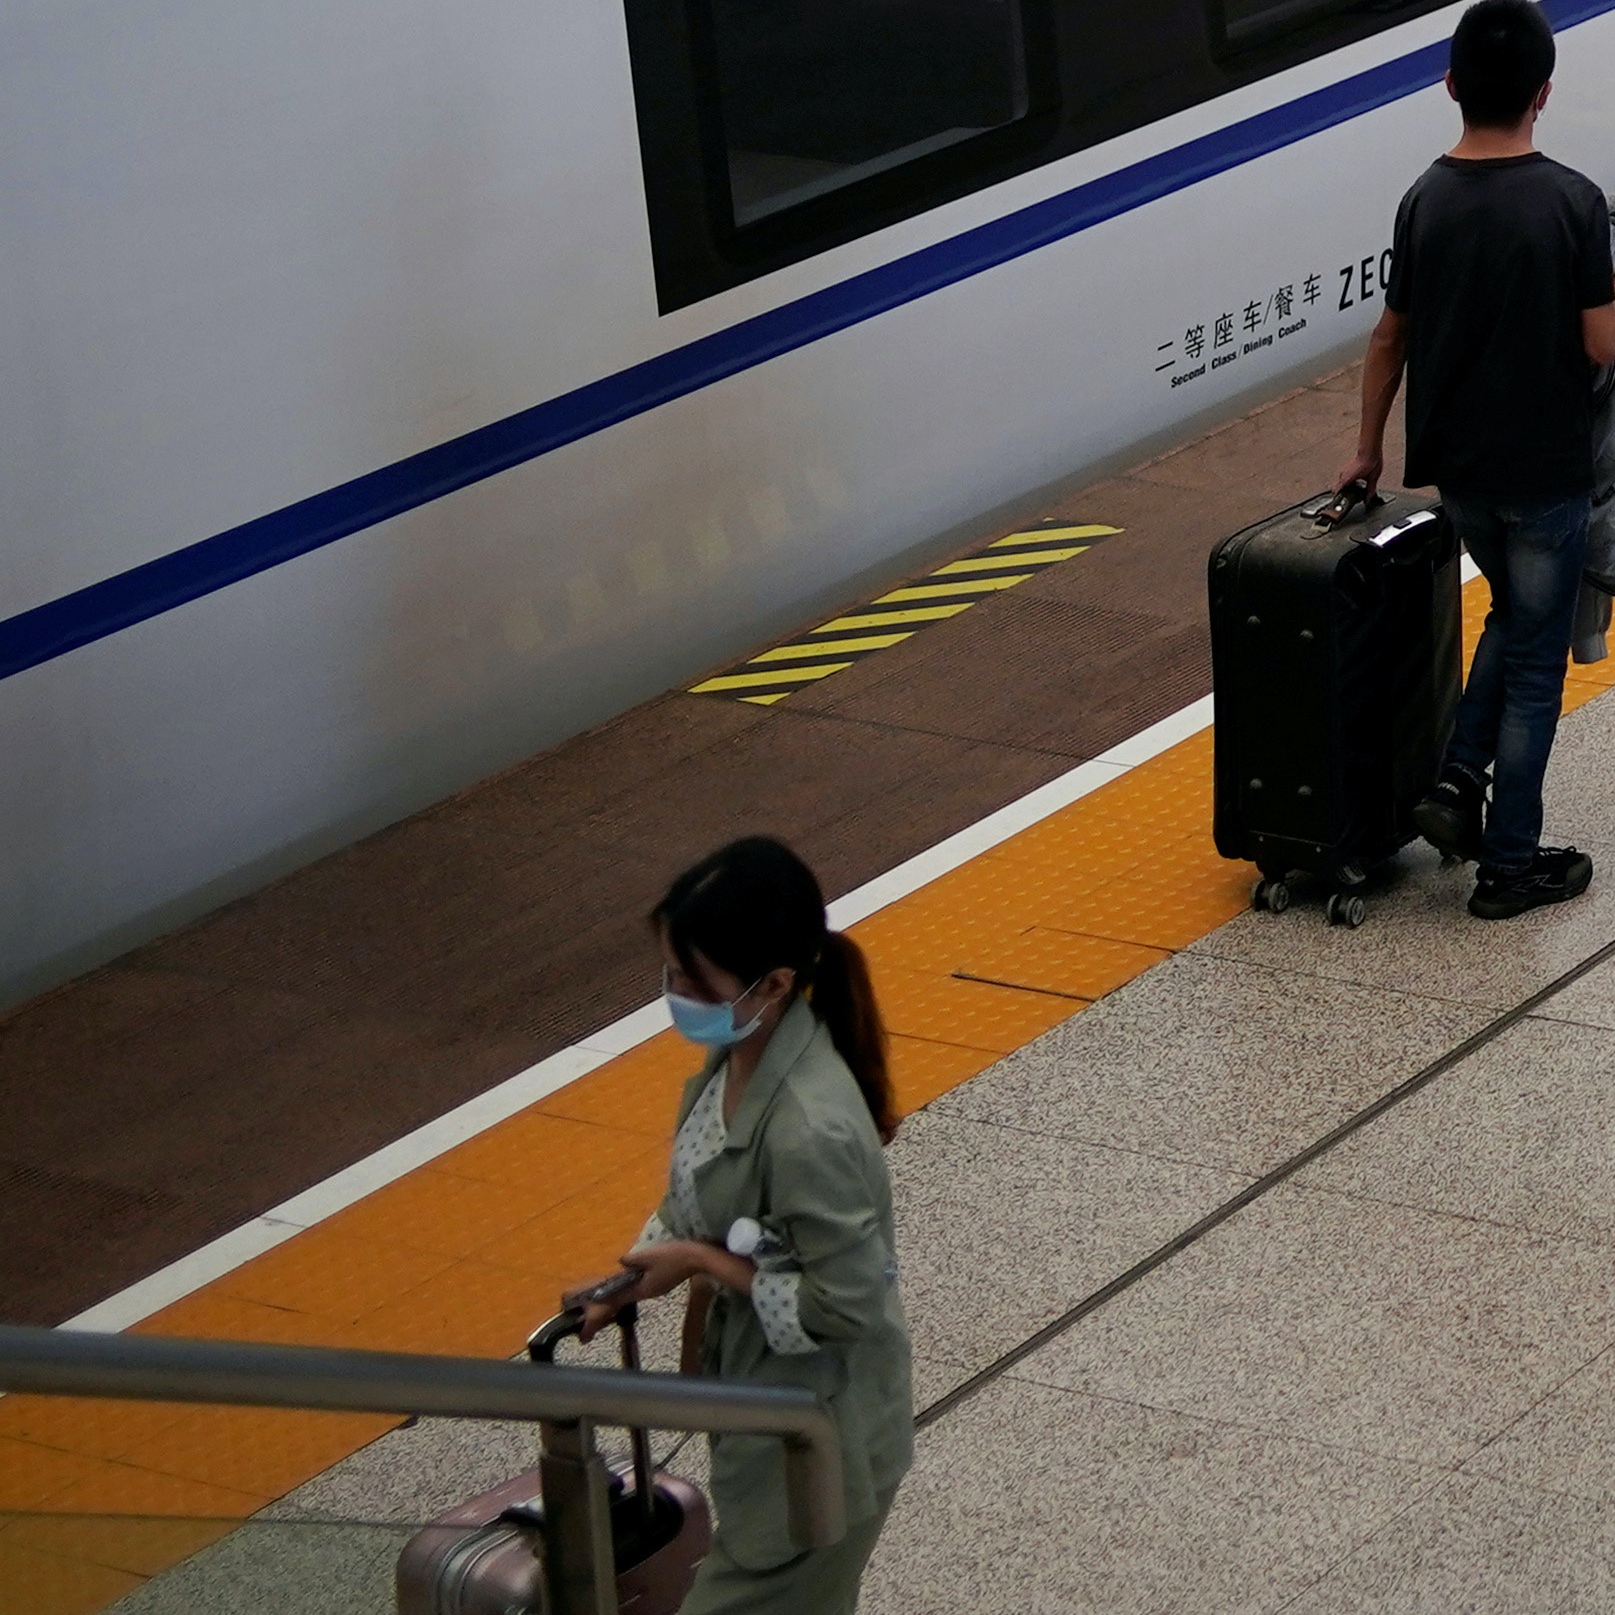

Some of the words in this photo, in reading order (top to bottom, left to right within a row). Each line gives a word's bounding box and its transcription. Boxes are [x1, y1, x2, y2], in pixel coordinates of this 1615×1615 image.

[1155, 273, 1322, 372] 二等座车/餐车
[1170, 363, 1206, 388] Second
[1278, 317, 1307, 339] Coach
